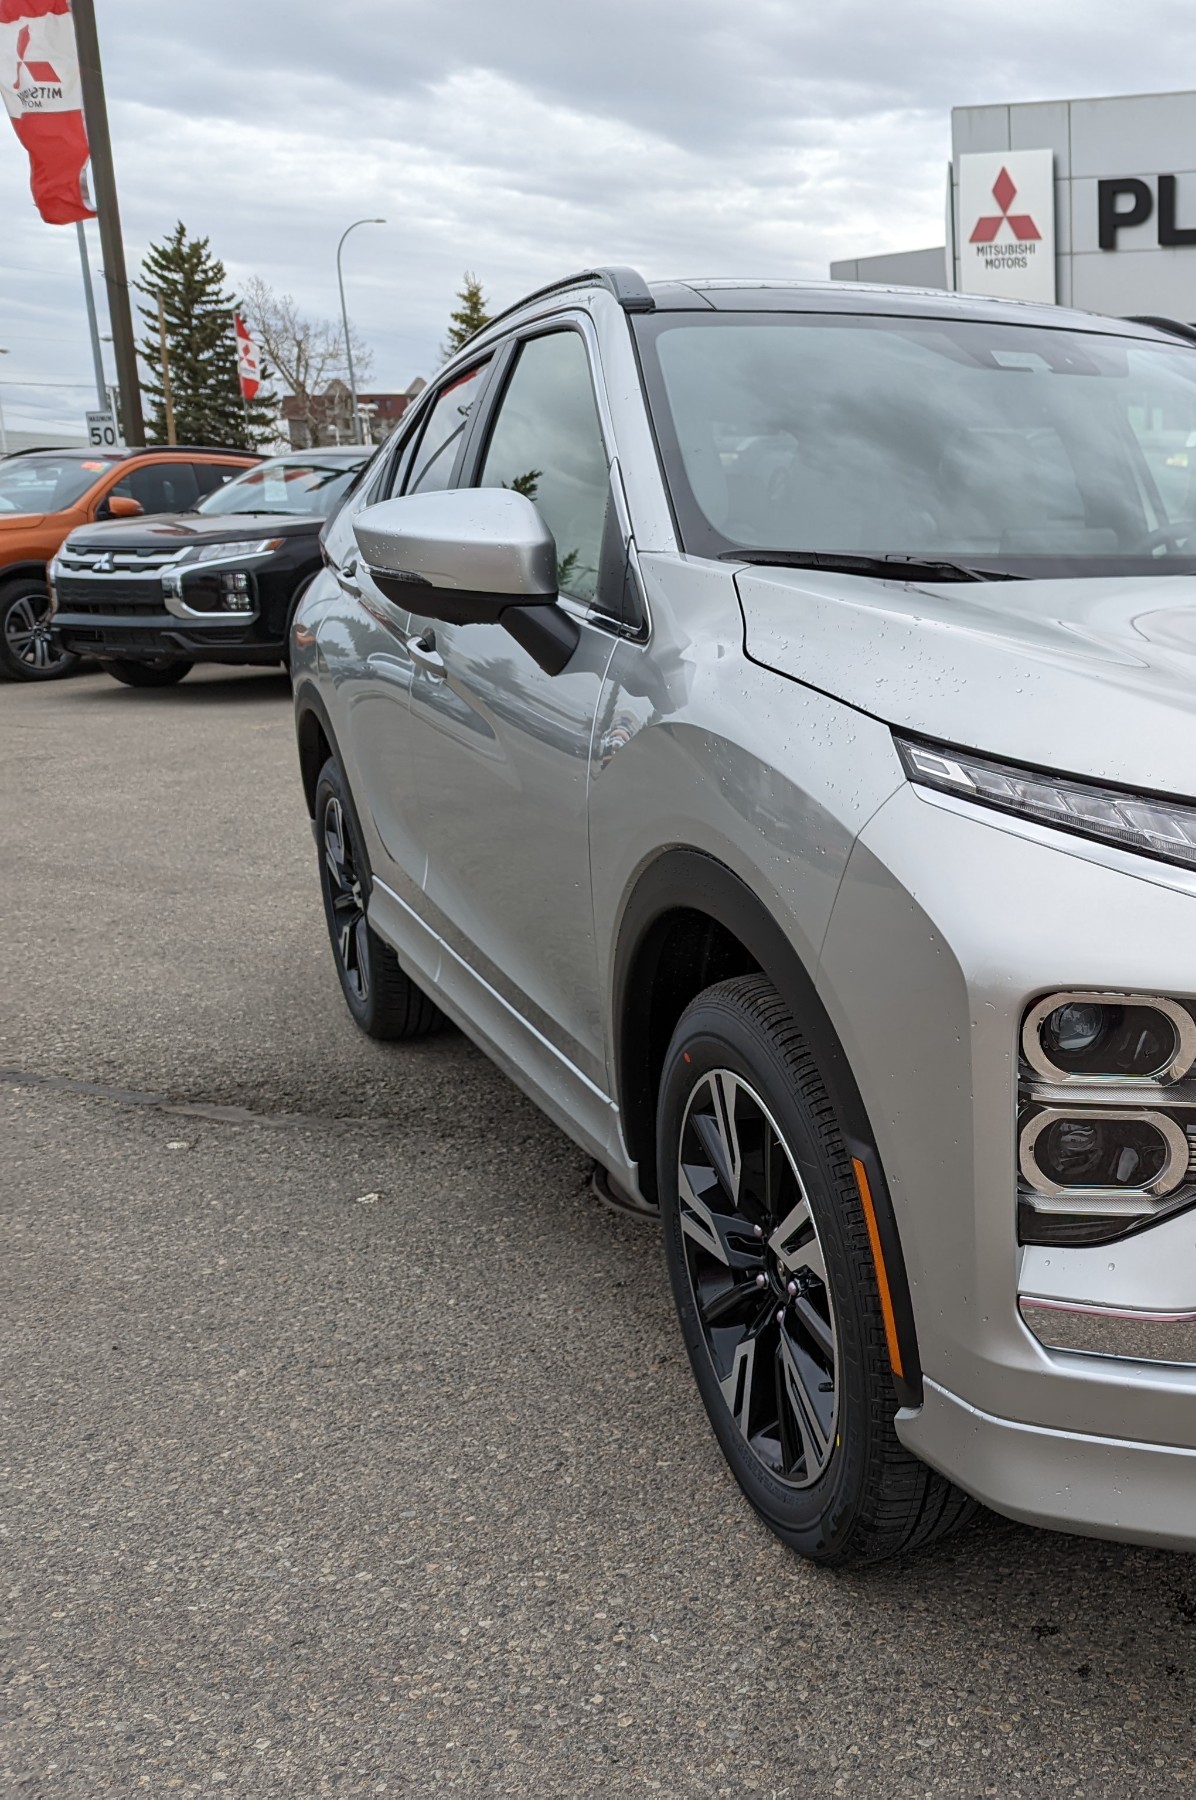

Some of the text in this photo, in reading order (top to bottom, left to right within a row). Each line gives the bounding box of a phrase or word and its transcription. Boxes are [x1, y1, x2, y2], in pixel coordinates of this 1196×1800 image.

[976, 243, 1036, 257] MITSUBISHI
[985, 257, 1028, 270] MOTORS
[90, 427, 115, 446] 50
